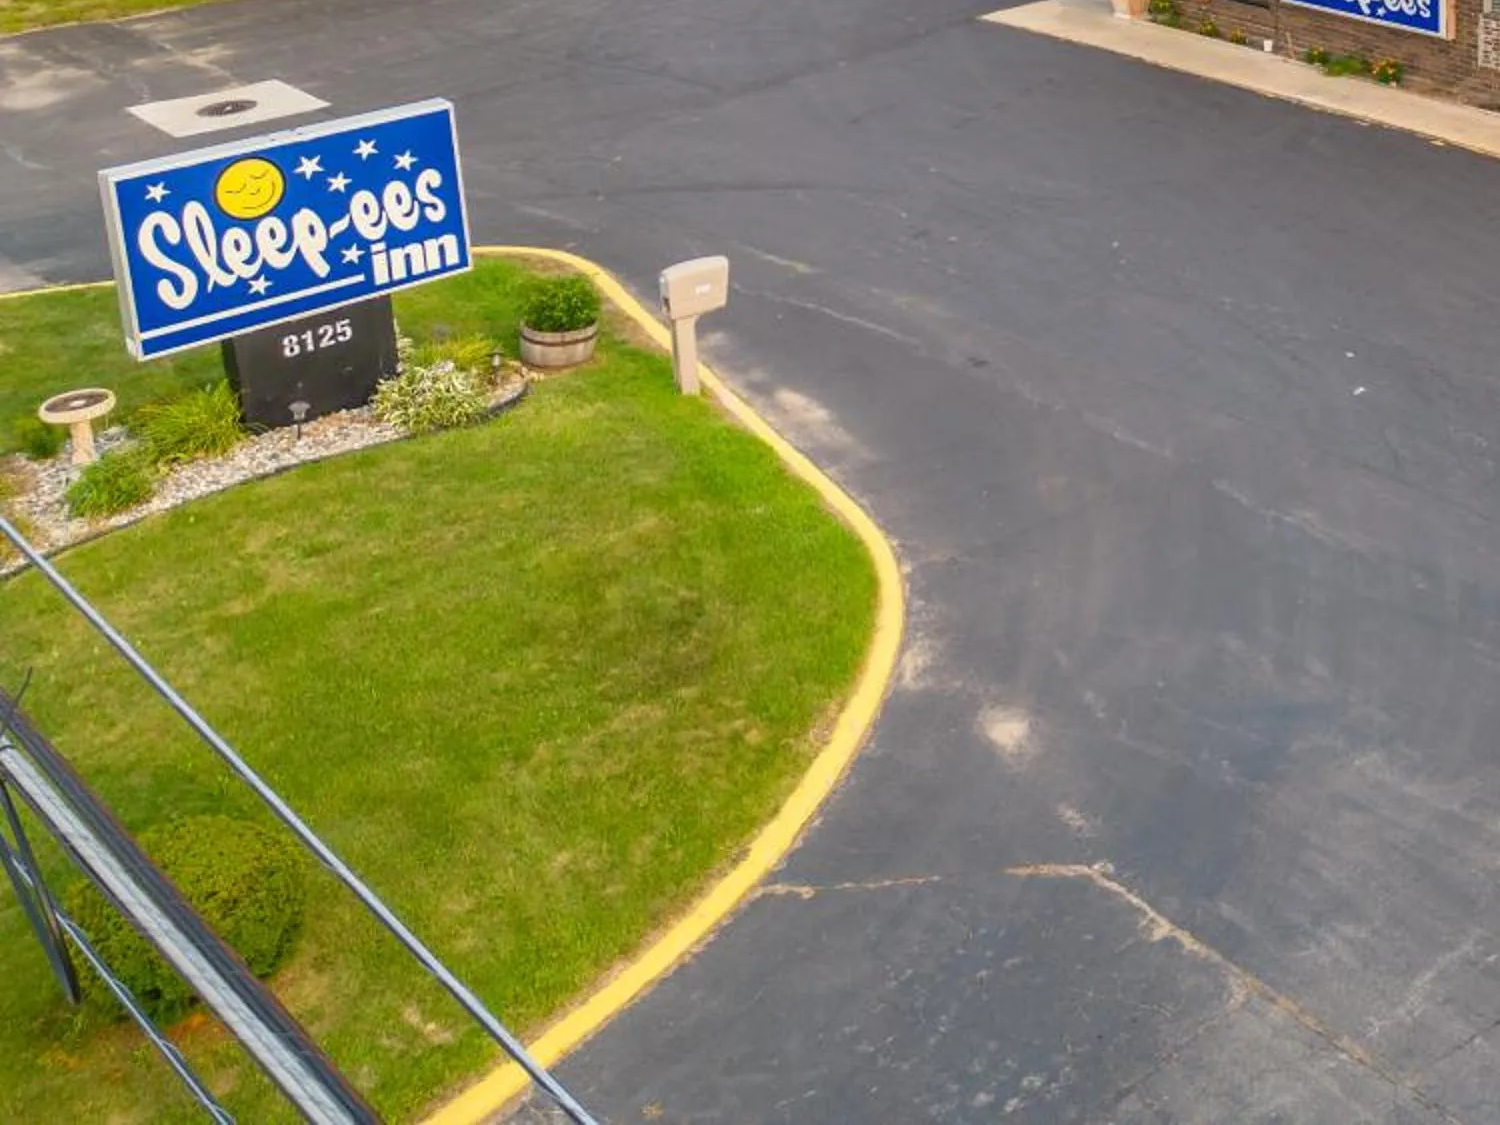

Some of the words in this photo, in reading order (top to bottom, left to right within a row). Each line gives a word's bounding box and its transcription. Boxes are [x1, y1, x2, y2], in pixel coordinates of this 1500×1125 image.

[138, 168, 447, 309] Sleep-ees
[370, 233, 460, 286] inn
[282, 318, 354, 358] 8125
